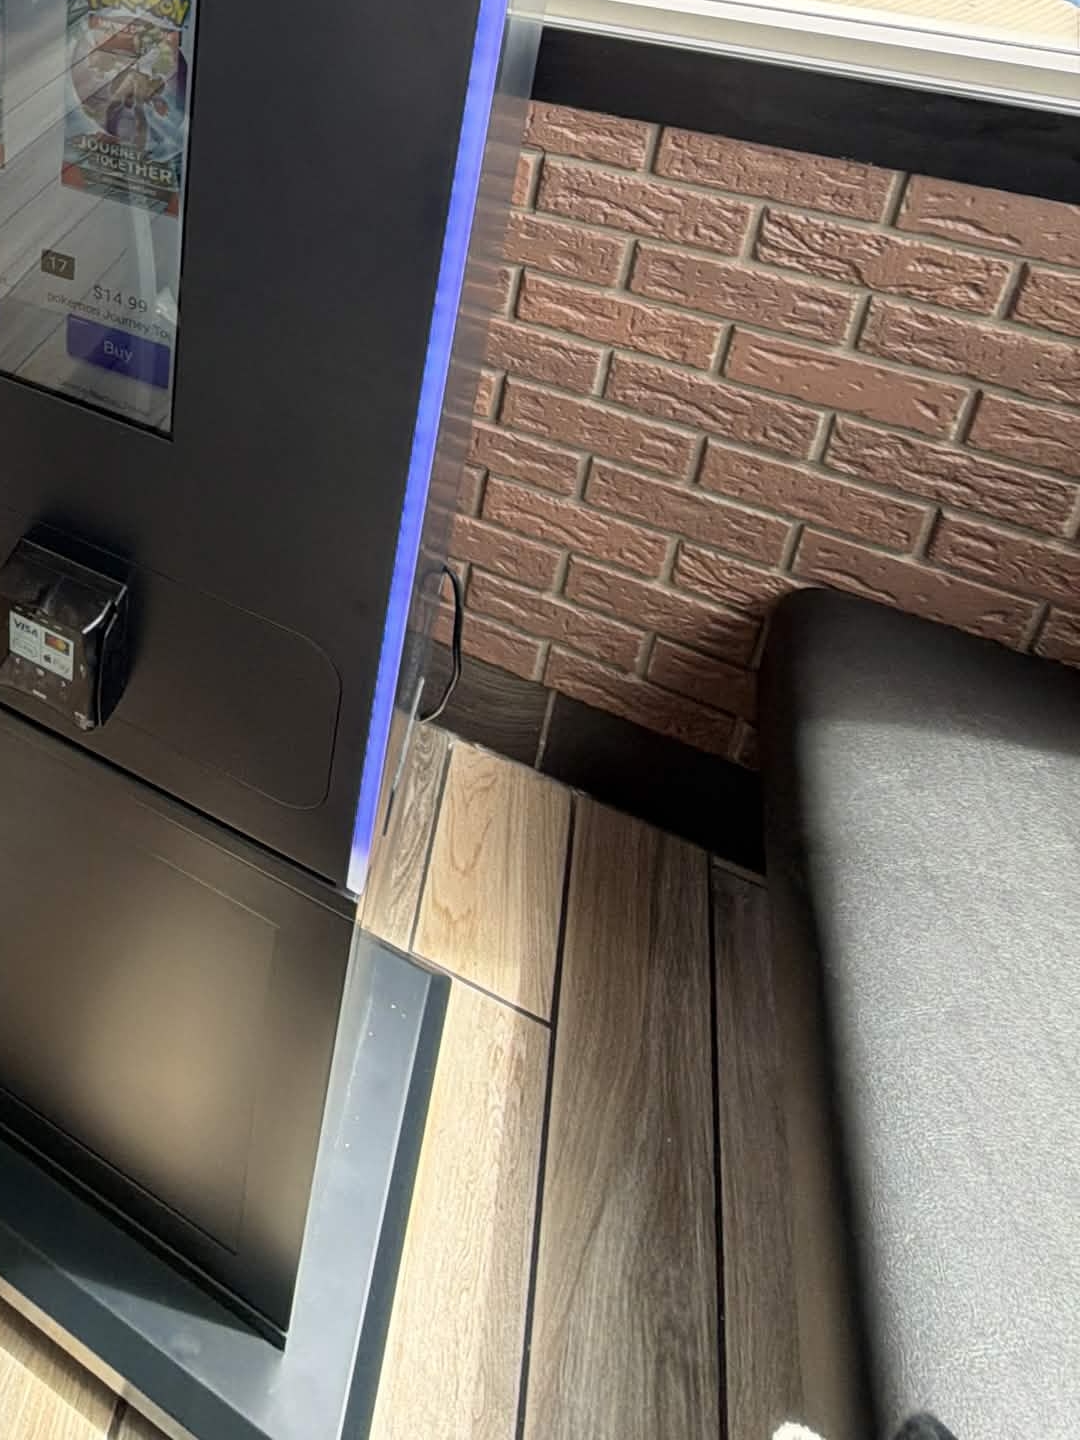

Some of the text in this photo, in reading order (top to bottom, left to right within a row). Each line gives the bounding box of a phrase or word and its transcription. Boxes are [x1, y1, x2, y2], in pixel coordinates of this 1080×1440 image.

[78, 135, 143, 161] JOURNEY
[96, 153, 173, 185] TOGETHER
[51, 257, 66, 271] 17
[92, 284, 148, 313] $14.99
[103, 339, 134, 364] Buy
[13, 617, 39, 640] VISA
